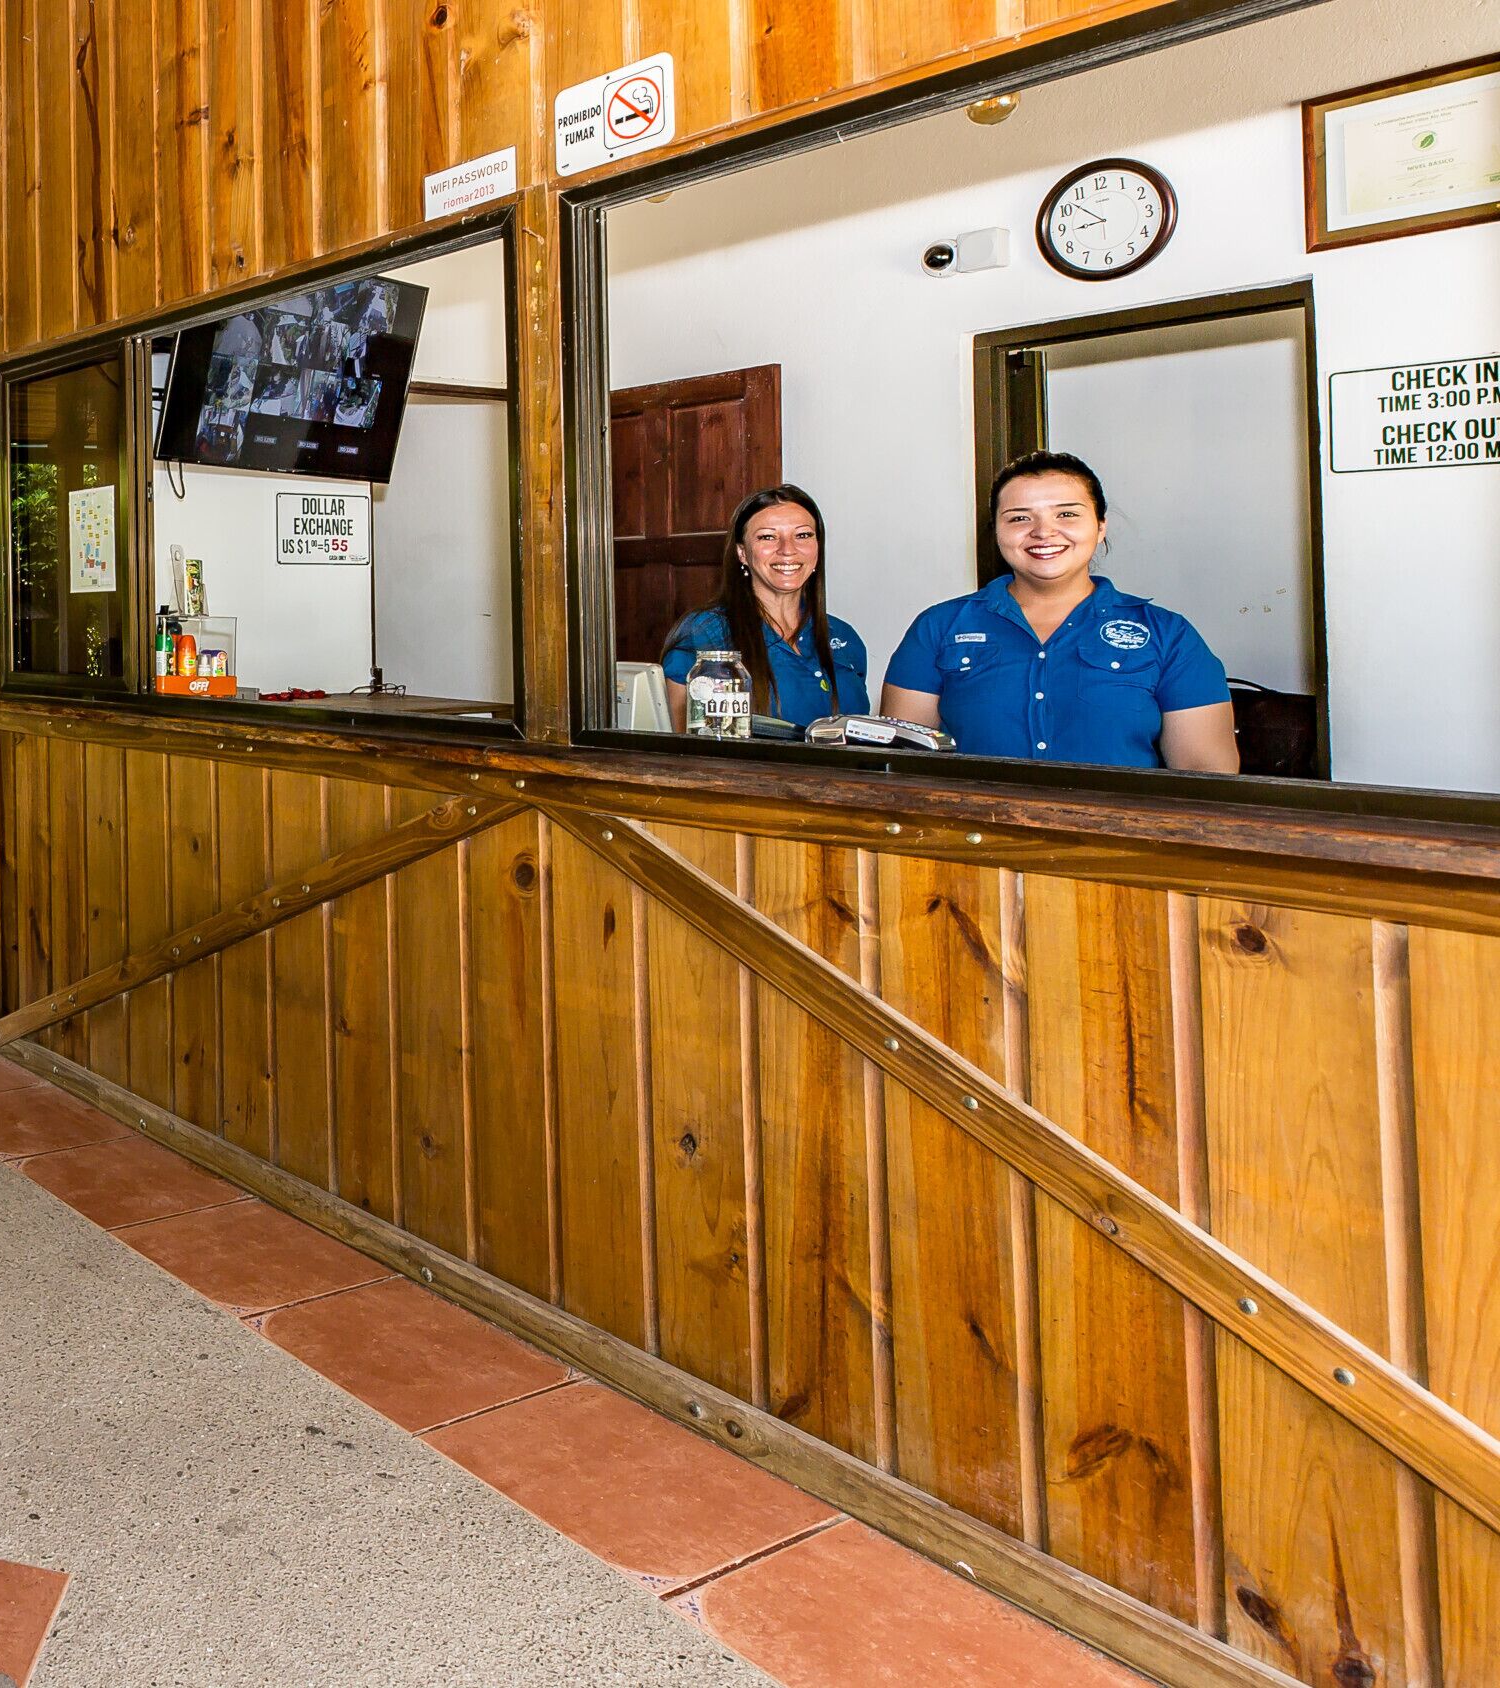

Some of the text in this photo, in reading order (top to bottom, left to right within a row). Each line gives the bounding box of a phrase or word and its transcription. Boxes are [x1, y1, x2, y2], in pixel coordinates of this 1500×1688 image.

[558, 104, 602, 129] PROHIBIDO
[564, 126, 595, 146] FUMAR
[431, 160, 508, 195] WIFI PASSWORD
[1094, 176, 1107, 190] 12
[1119, 177, 1126, 190] 1
[443, 184, 495, 209] riomar2013
[1075, 187, 1085, 201] 11
[1137, 187, 1146, 200] 2
[1060, 204, 1073, 218] 10
[1145, 204, 1154, 218] 3
[1058, 224, 1066, 237] 9
[1139, 225, 1149, 238] 4
[1066, 241, 1074, 254] 8
[1127, 242, 1135, 256] 5
[1082, 251, 1090, 265] 7
[1104, 252, 1113, 265] 6
[1391, 361, 1499, 392] CHECK IN
[1377, 394, 1422, 413] TIME
[1427, 389, 1470, 409] 3:00
[1382, 420, 1457, 446] CHECK
[1373, 446, 1417, 466] TIME
[1425, 442, 1479, 462] 12:00
[302, 497, 345, 516] DOLLAR
[293, 517, 354, 536] EXCHANGE
[282, 539, 295, 554] US
[189, 680, 210, 691] OFF!
